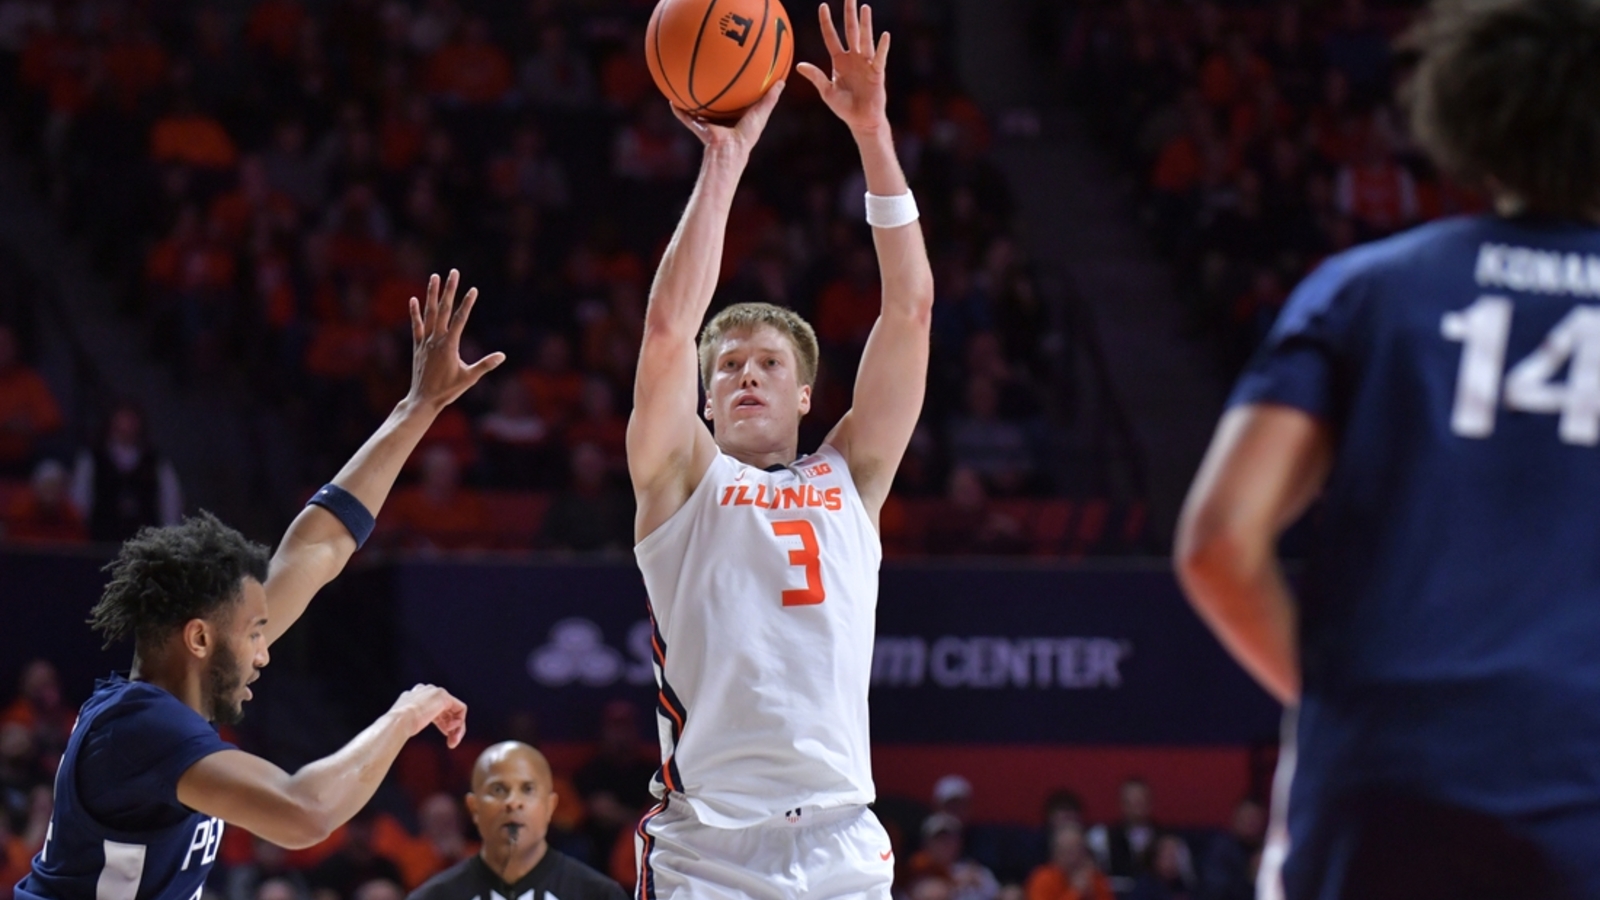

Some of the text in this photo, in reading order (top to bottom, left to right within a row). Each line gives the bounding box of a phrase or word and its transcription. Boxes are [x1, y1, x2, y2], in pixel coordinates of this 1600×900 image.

[1440, 295, 1600, 446] 14
[720, 484, 842, 511] ILLINOS
[771, 519, 826, 607] 3
[931, 635, 1121, 689] CENTER
